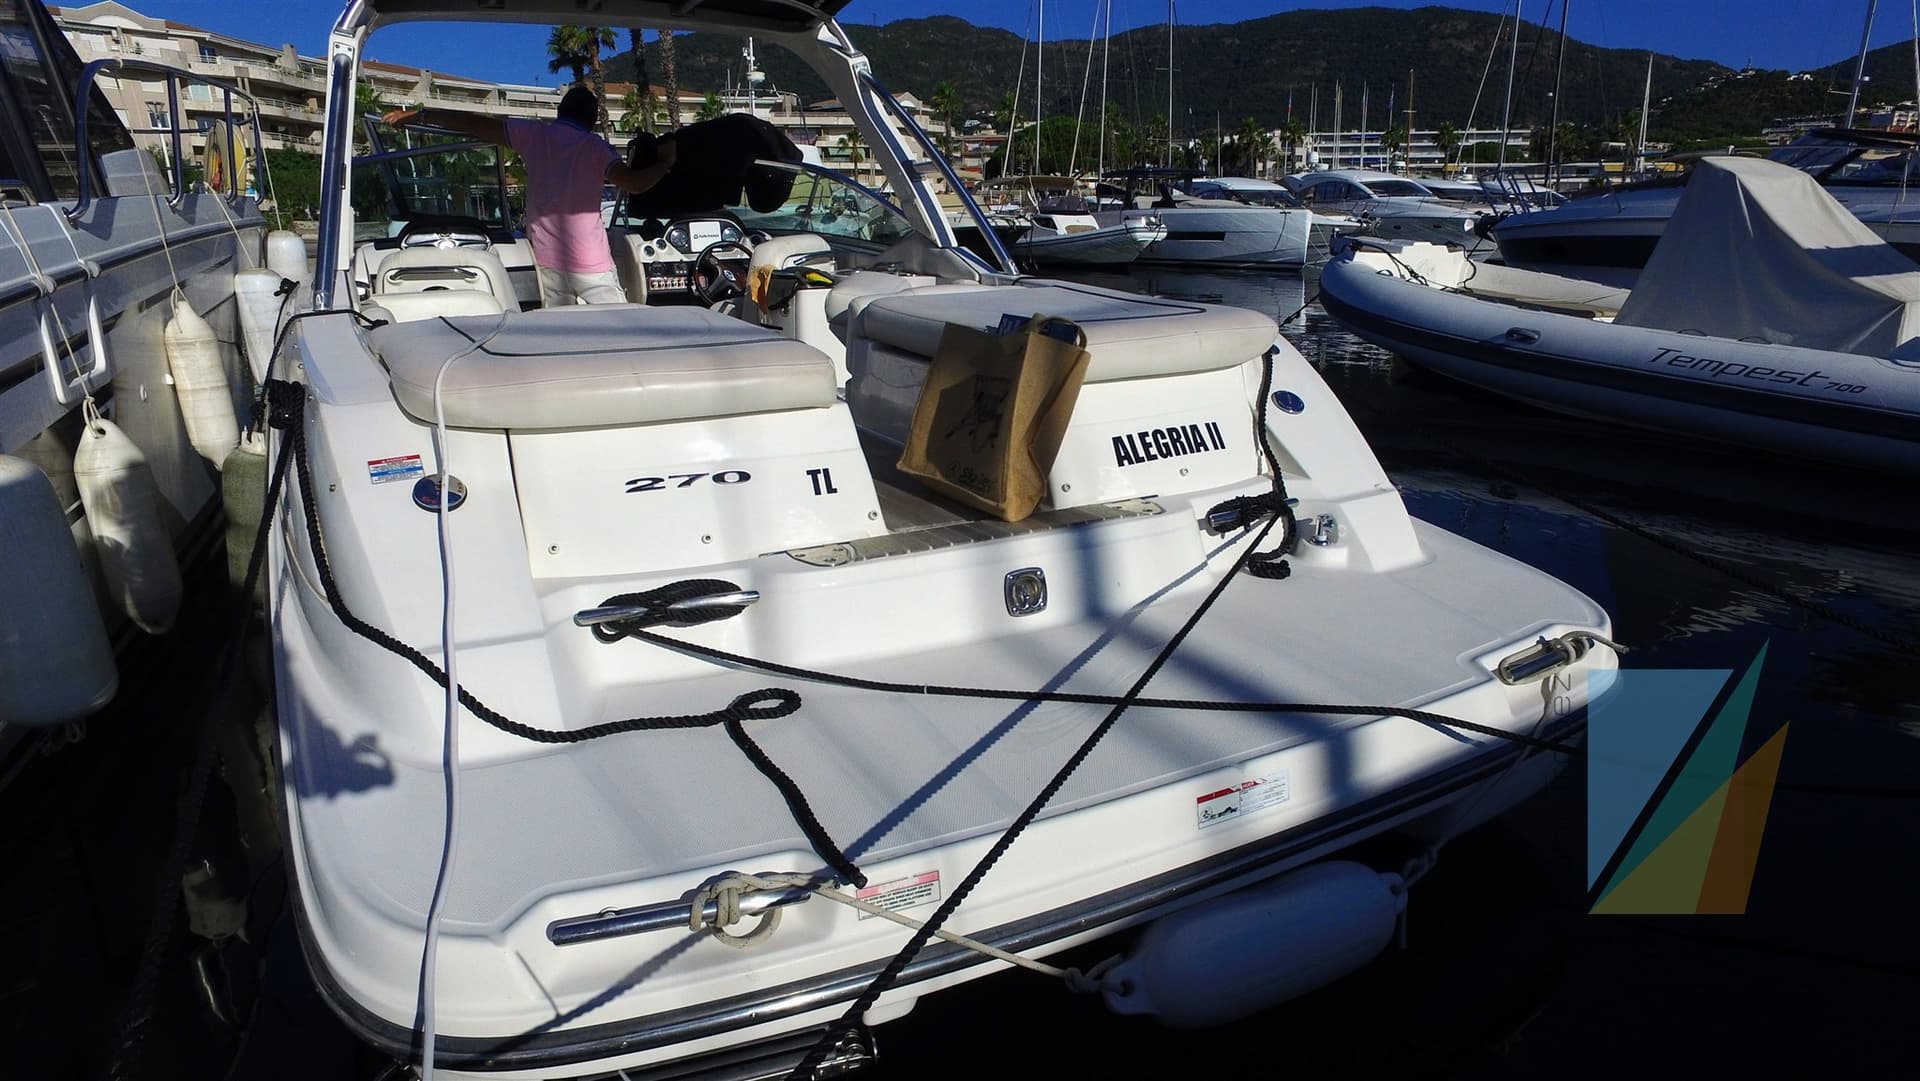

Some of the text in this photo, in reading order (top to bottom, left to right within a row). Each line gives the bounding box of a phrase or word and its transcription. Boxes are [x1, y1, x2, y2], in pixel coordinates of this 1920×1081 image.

[1650, 347, 1868, 395] Tempest 700
[1111, 421, 1227, 468] ALEGRIA II
[625, 467, 838, 496] 270 TL
